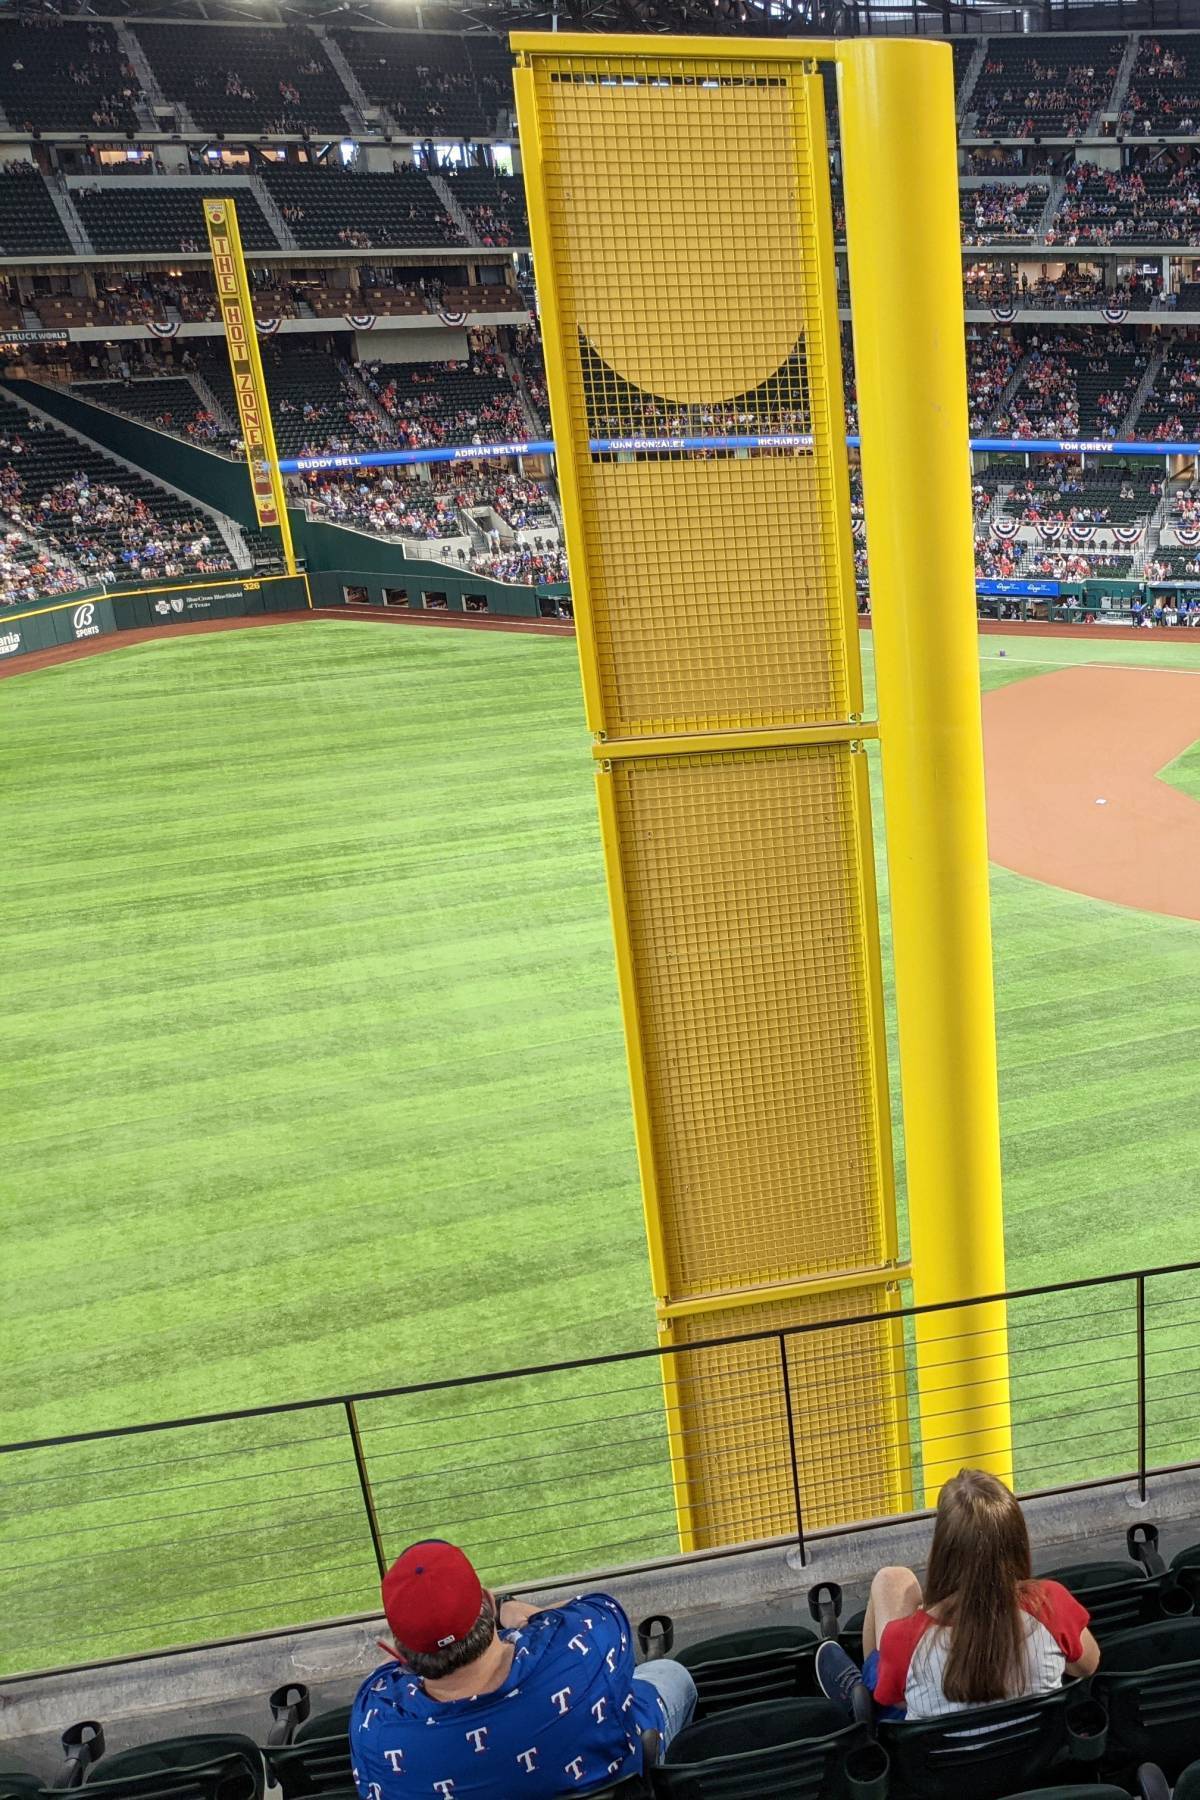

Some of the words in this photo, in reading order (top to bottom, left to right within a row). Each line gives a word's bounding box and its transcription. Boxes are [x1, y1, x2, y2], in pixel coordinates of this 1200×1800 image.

[216, 238, 233, 291] THE
[227, 307, 246, 360] HOT
[239, 376, 260, 444] ZONE
[1059, 442, 1079, 450] TOM
[1080, 443, 1113, 451] GRIEVE
[297, 459, 332, 469] BUDDY
[335, 456, 361, 466] BELL
[243, 582, 260, 591] 326
[75, 625, 99, 638] SPORTS
[567, 1634, 590, 1656] T
[551, 1686, 571, 1714] T
[591, 1696, 607, 1724] T
[466, 1726, 488, 1752] T
[384, 1749, 403, 1772] T
[517, 1746, 537, 1773] T
[564, 1756, 583, 1781] T
